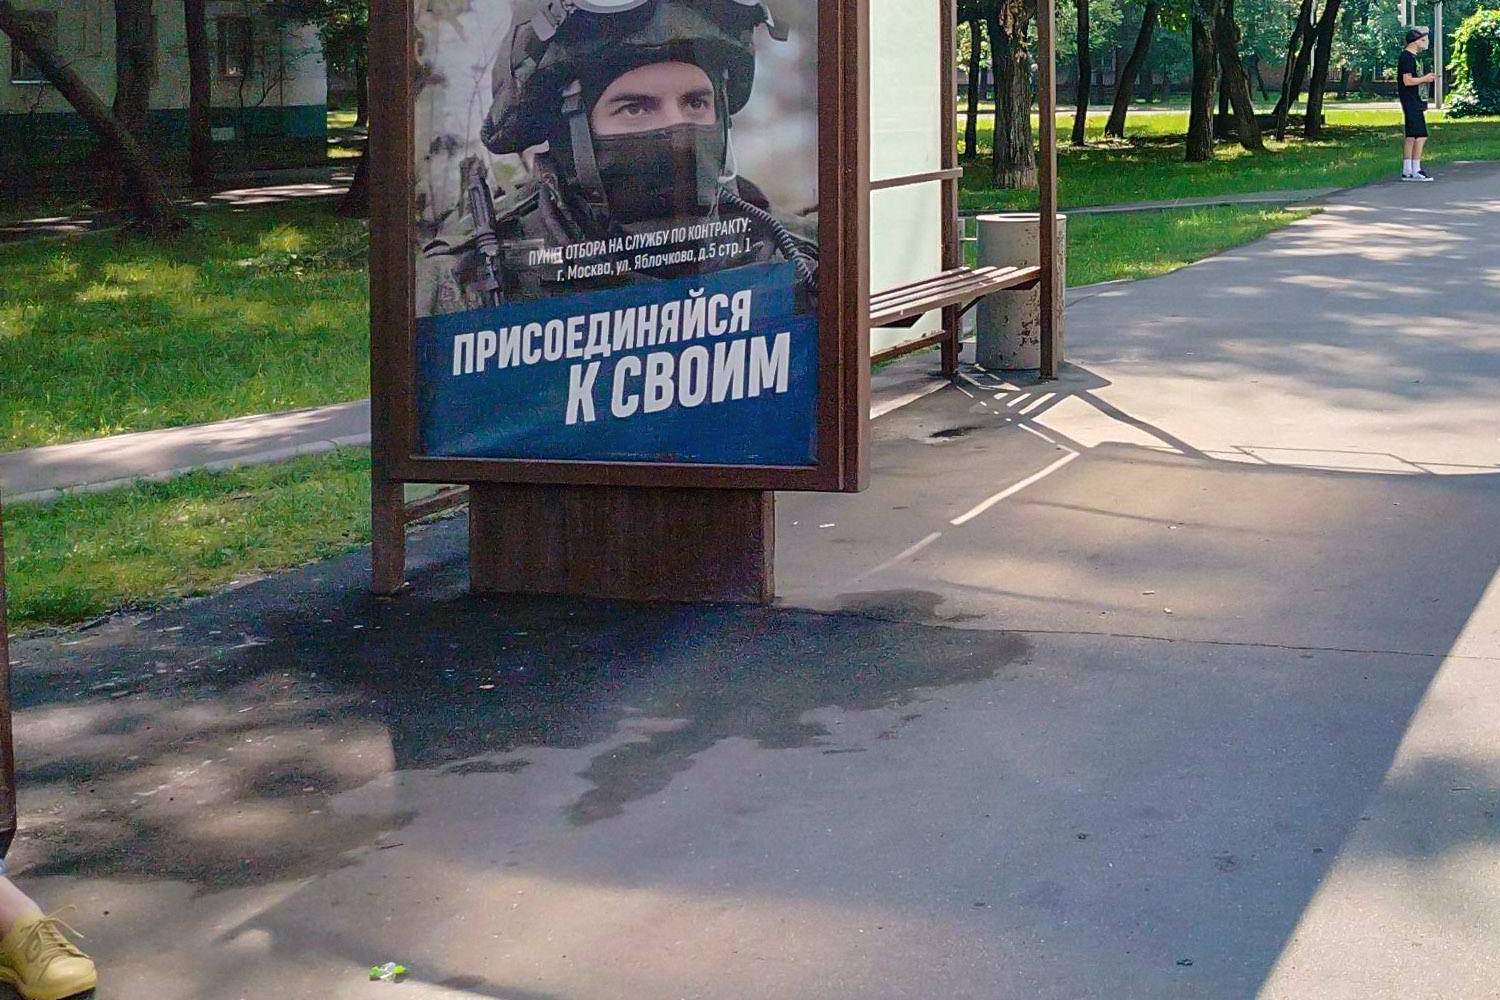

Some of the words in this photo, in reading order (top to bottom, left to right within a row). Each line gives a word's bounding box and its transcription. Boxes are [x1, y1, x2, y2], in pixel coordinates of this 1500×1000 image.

[529, 246, 564, 266] ПУНКТ
[565, 240, 606, 260] ОТБОРА
[608, 237, 625, 253] НА
[625, 230, 669, 250] СЛУЖБУ
[671, 227, 686, 244] ПО
[688, 217, 752, 241] КОНТРАКТУ:
[557, 269, 565, 281] г.
[568, 262, 614, 280] Москва,
[616, 259, 632, 275] ул.
[634, 249, 697, 270] Яблочкова,
[718, 242, 742, 257] стр.
[745, 237, 751, 252] 1
[452, 287, 752, 376] ПРИСОЕДИНЯЙСЯ
[565, 360, 601, 425] К
[611, 332, 791, 418] СВОИМ
